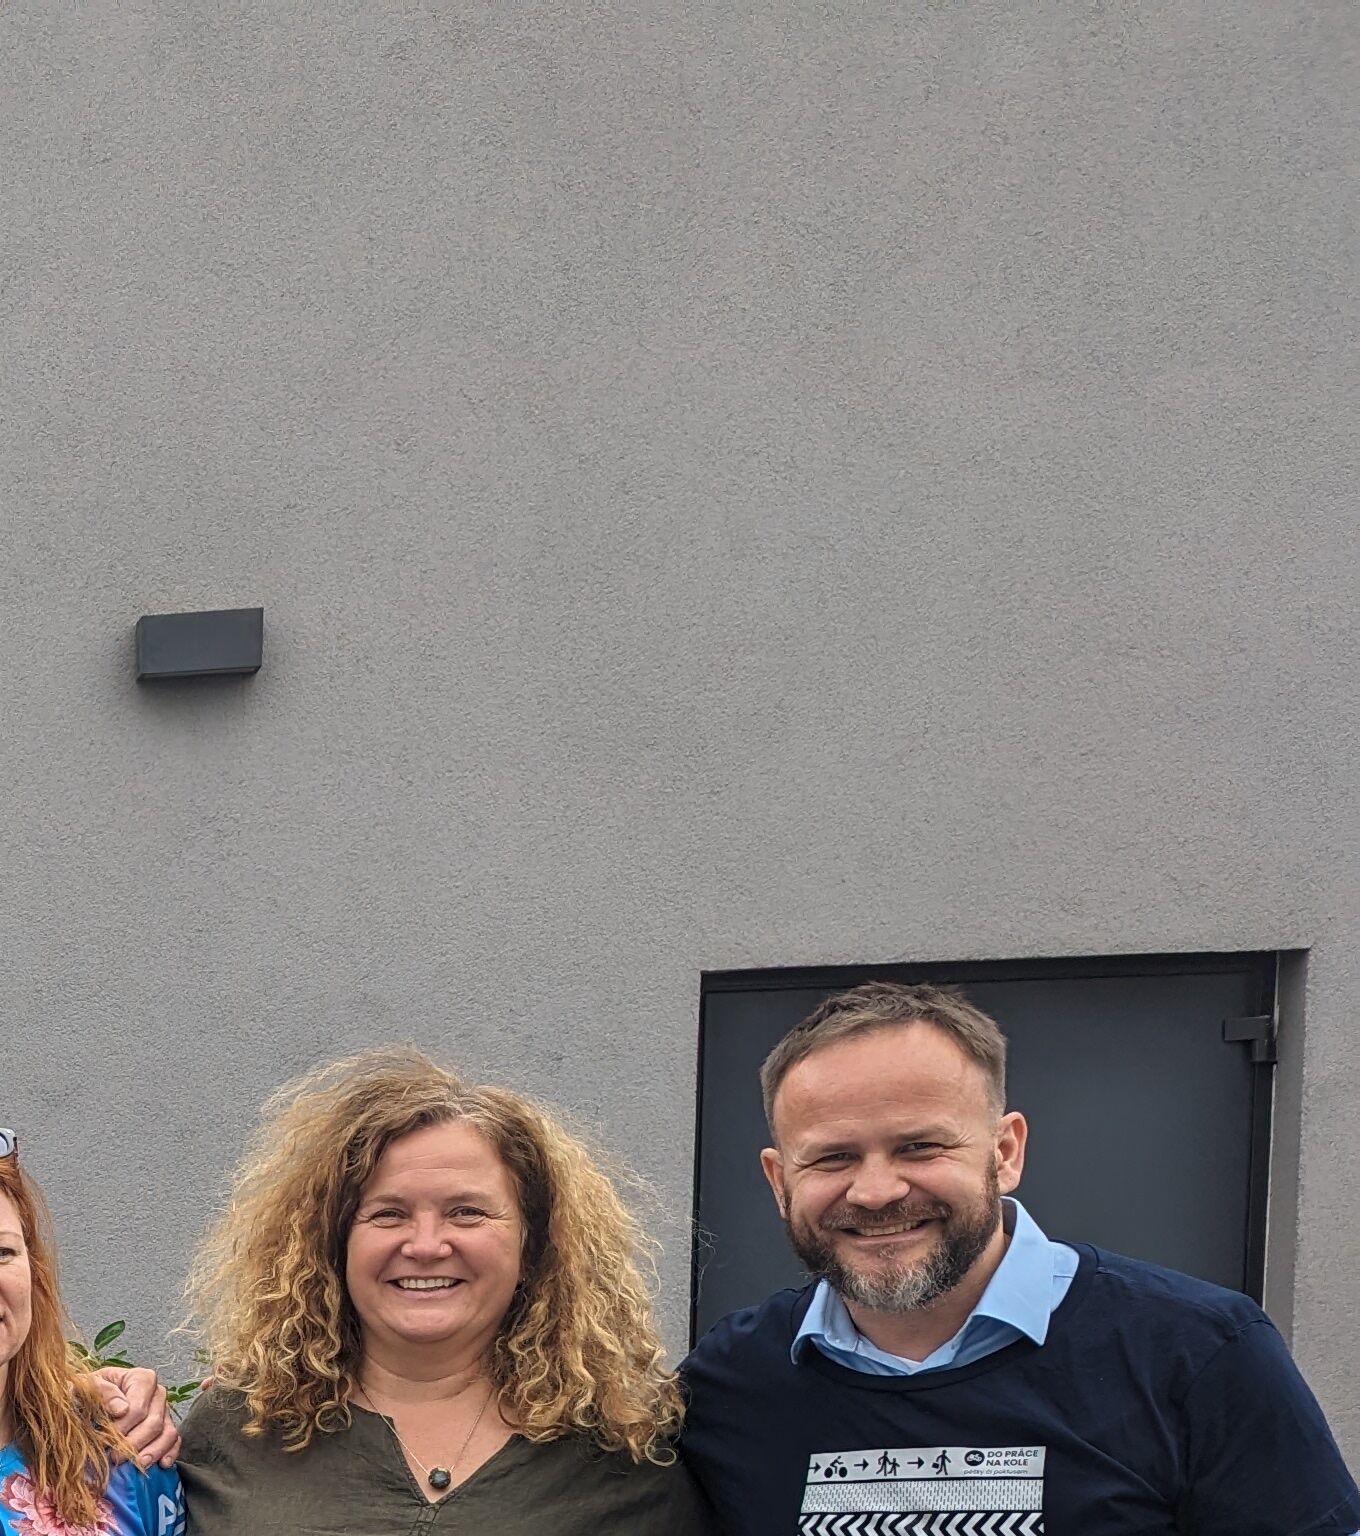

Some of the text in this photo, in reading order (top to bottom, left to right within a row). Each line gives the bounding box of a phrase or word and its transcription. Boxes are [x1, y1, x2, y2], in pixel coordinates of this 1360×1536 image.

[987, 1448, 1039, 1458] DO PRÁCE
[986, 1459, 1029, 1467] NA KOLE
